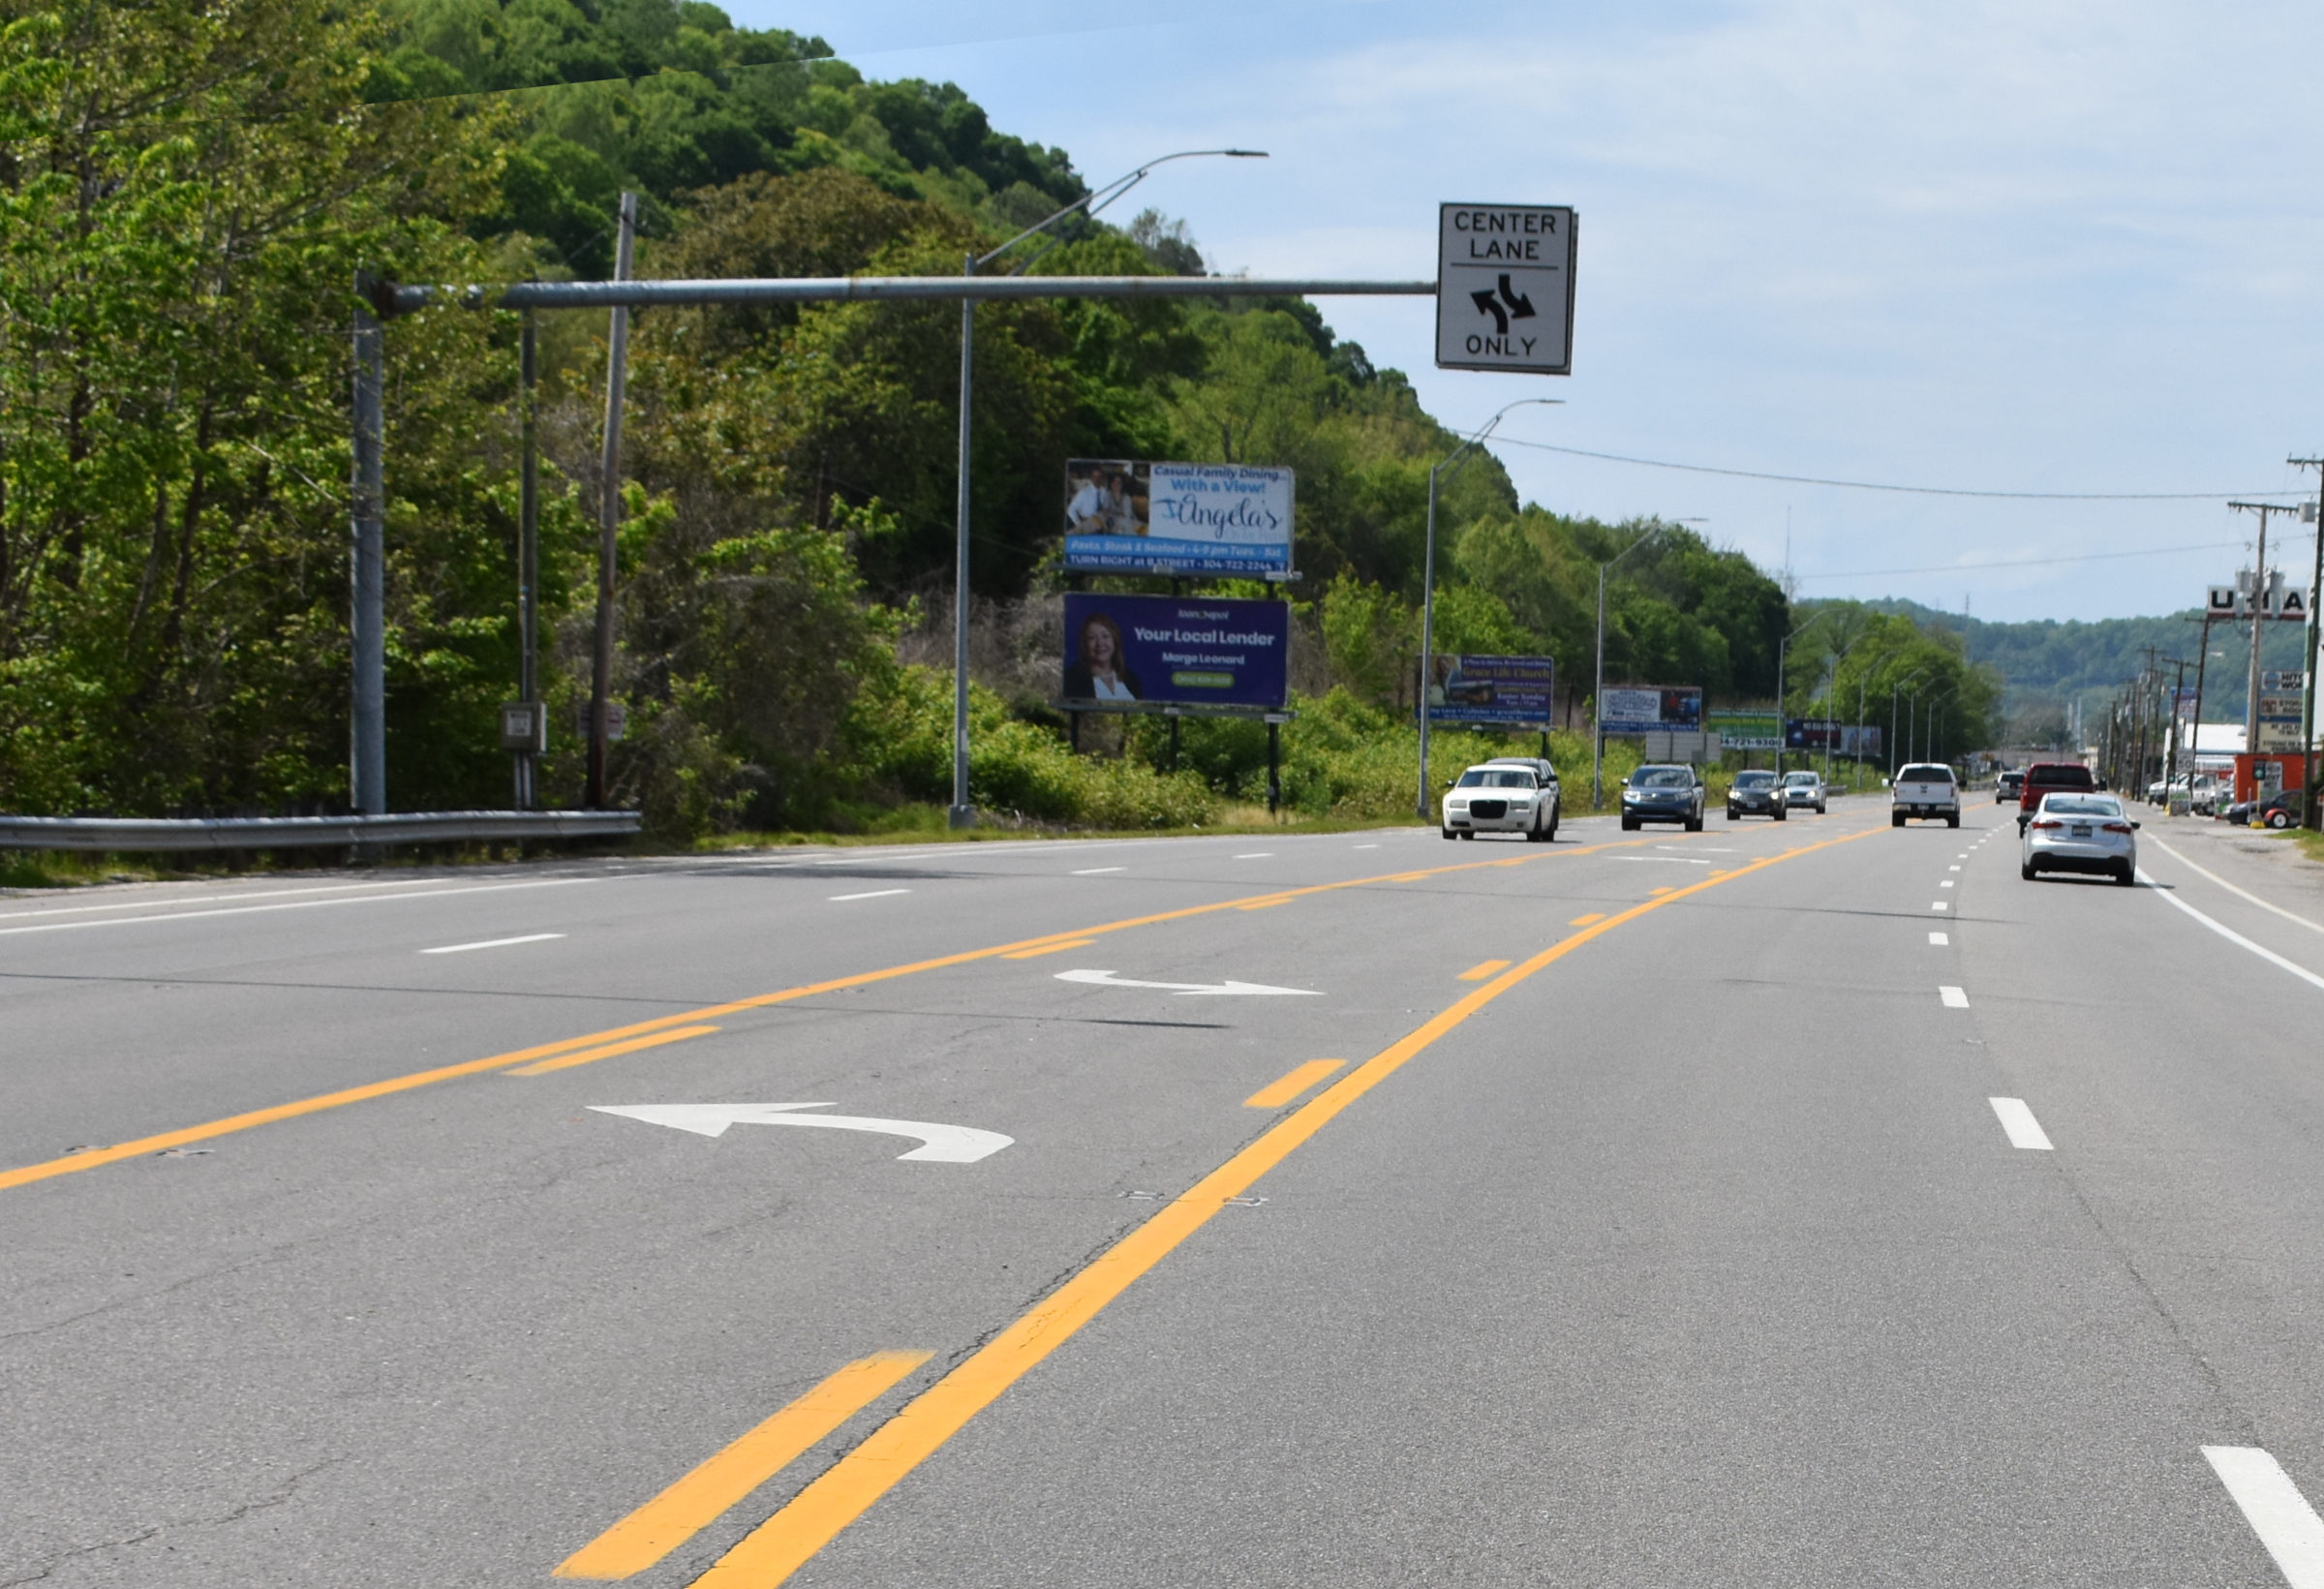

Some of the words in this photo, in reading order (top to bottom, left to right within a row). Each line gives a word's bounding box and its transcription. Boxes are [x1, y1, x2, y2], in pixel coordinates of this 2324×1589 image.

[1454, 211, 1556, 233] CENTER
[1470, 238, 1540, 260] LANE
[1466, 335, 1537, 356] ONLY
[1154, 466, 1194, 476] Casual
[1197, 467, 1238, 479] Family
[1170, 478, 1208, 492] With
[1210, 482, 1220, 492] a
[1223, 480, 1266, 494] View!
[1134, 627, 1172, 642] Your
[1175, 628, 1216, 644] Local
[1219, 630, 1274, 646] Lender
[1514, 666, 1549, 678] Church
